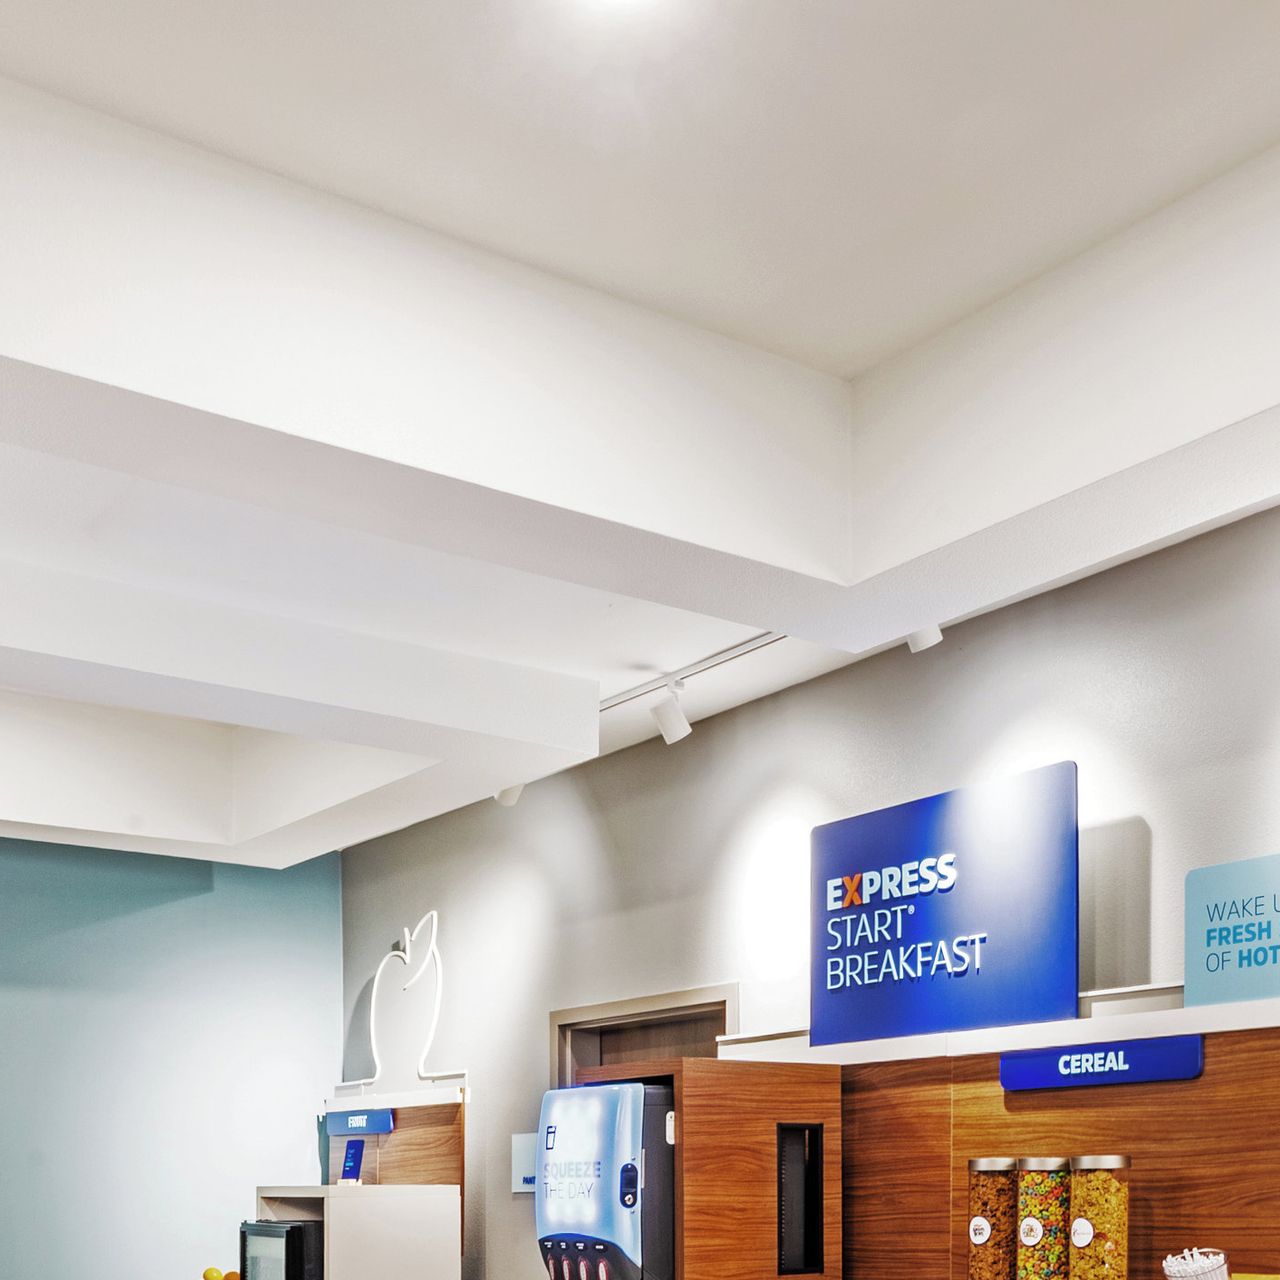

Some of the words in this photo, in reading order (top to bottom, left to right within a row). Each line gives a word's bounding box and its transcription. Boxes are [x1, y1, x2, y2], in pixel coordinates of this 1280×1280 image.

[826, 853, 957, 911] EXPRESS
[1206, 895, 1265, 922] WAKE
[1206, 921, 1271, 947] FRESH
[826, 933, 988, 990] BREAKFAST
[1206, 951, 1231, 972] OF
[1238, 945, 1280, 968] HOT
[1058, 1051, 1129, 1075] CEREAL
[348, 1115, 367, 1128] FRUIT
[544, 1161, 601, 1178] SQUEEZE
[544, 1182, 564, 1199] THE
[568, 1182, 594, 1199] DAY
